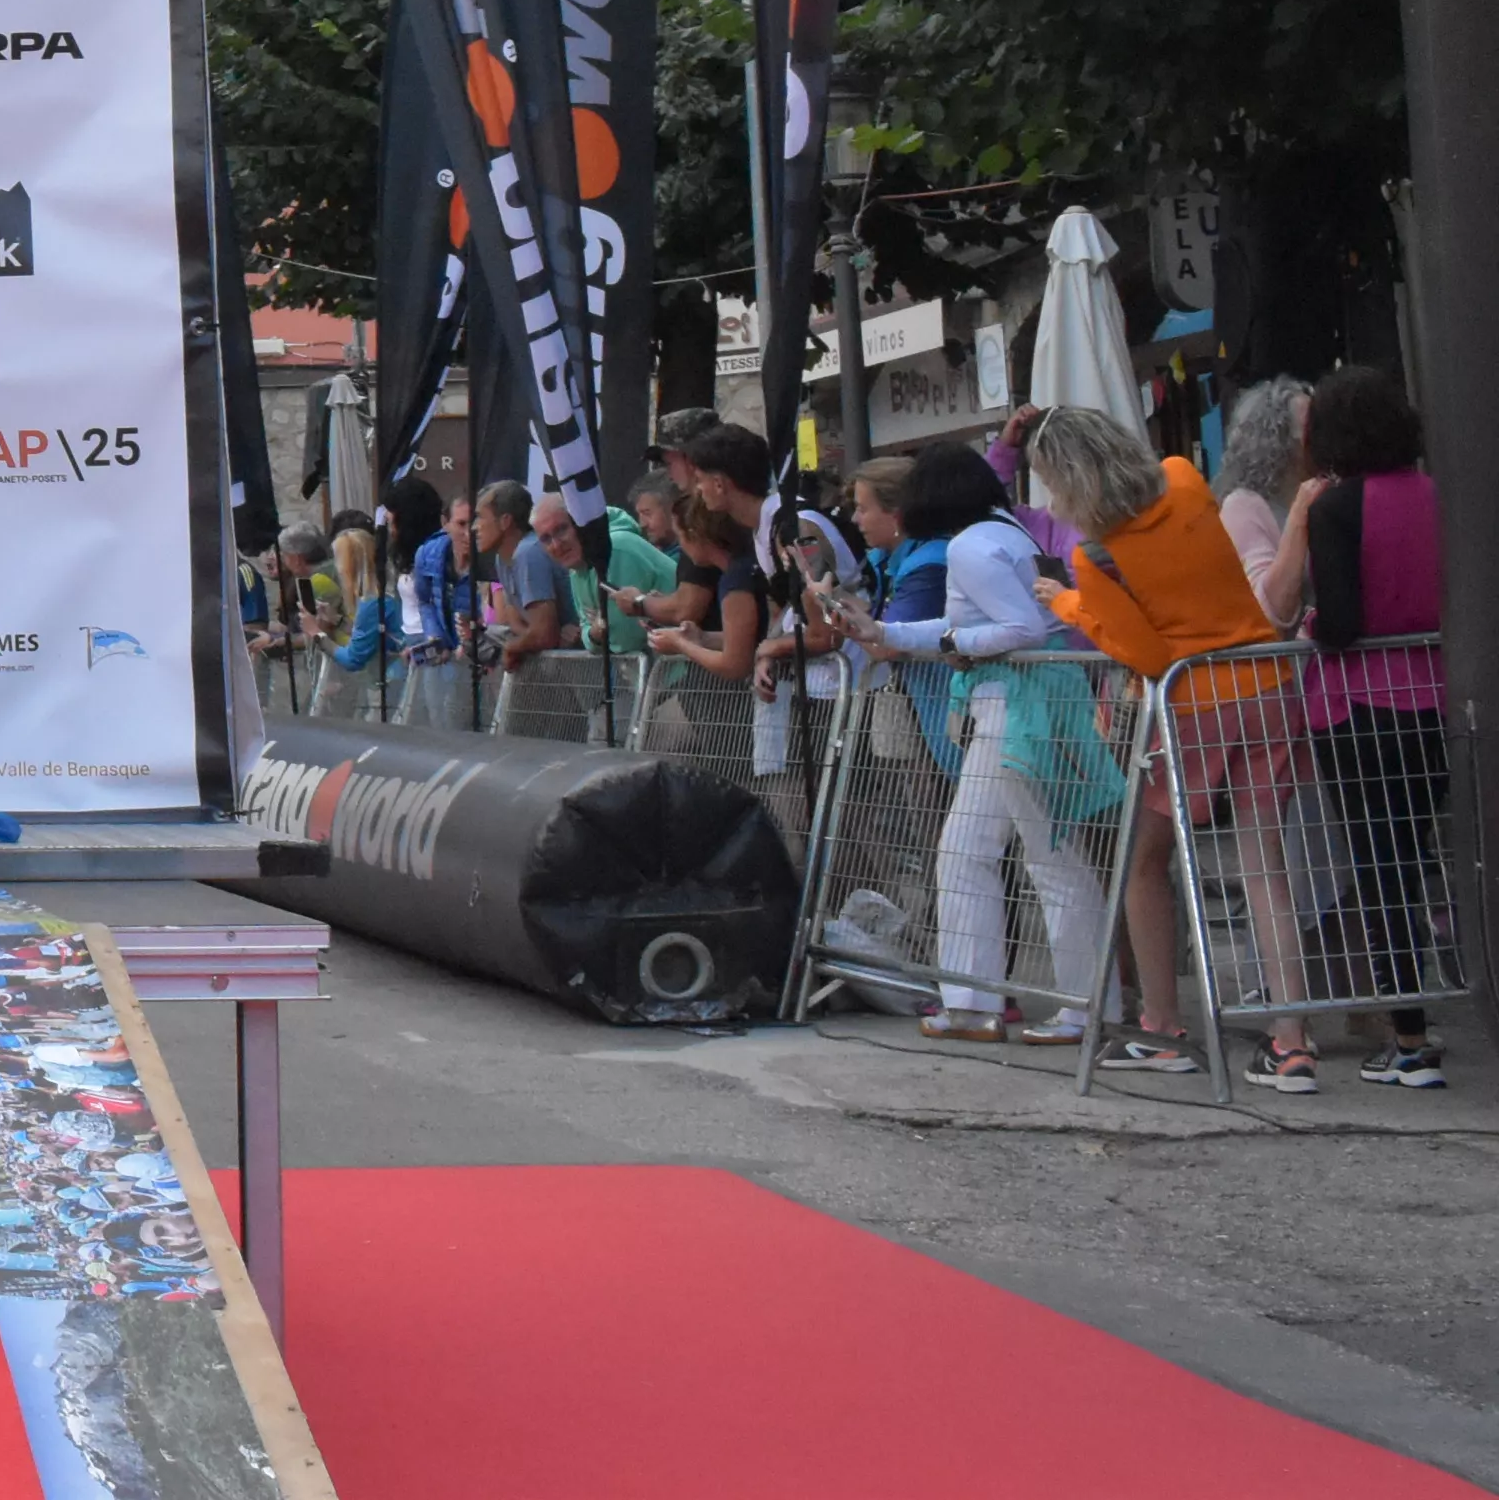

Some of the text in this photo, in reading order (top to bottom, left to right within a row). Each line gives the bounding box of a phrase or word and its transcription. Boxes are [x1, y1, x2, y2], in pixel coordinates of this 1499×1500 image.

[866, 329, 905, 357] vinos
[42, 762, 63, 777] de
[67, 761, 150, 779] Benasque
